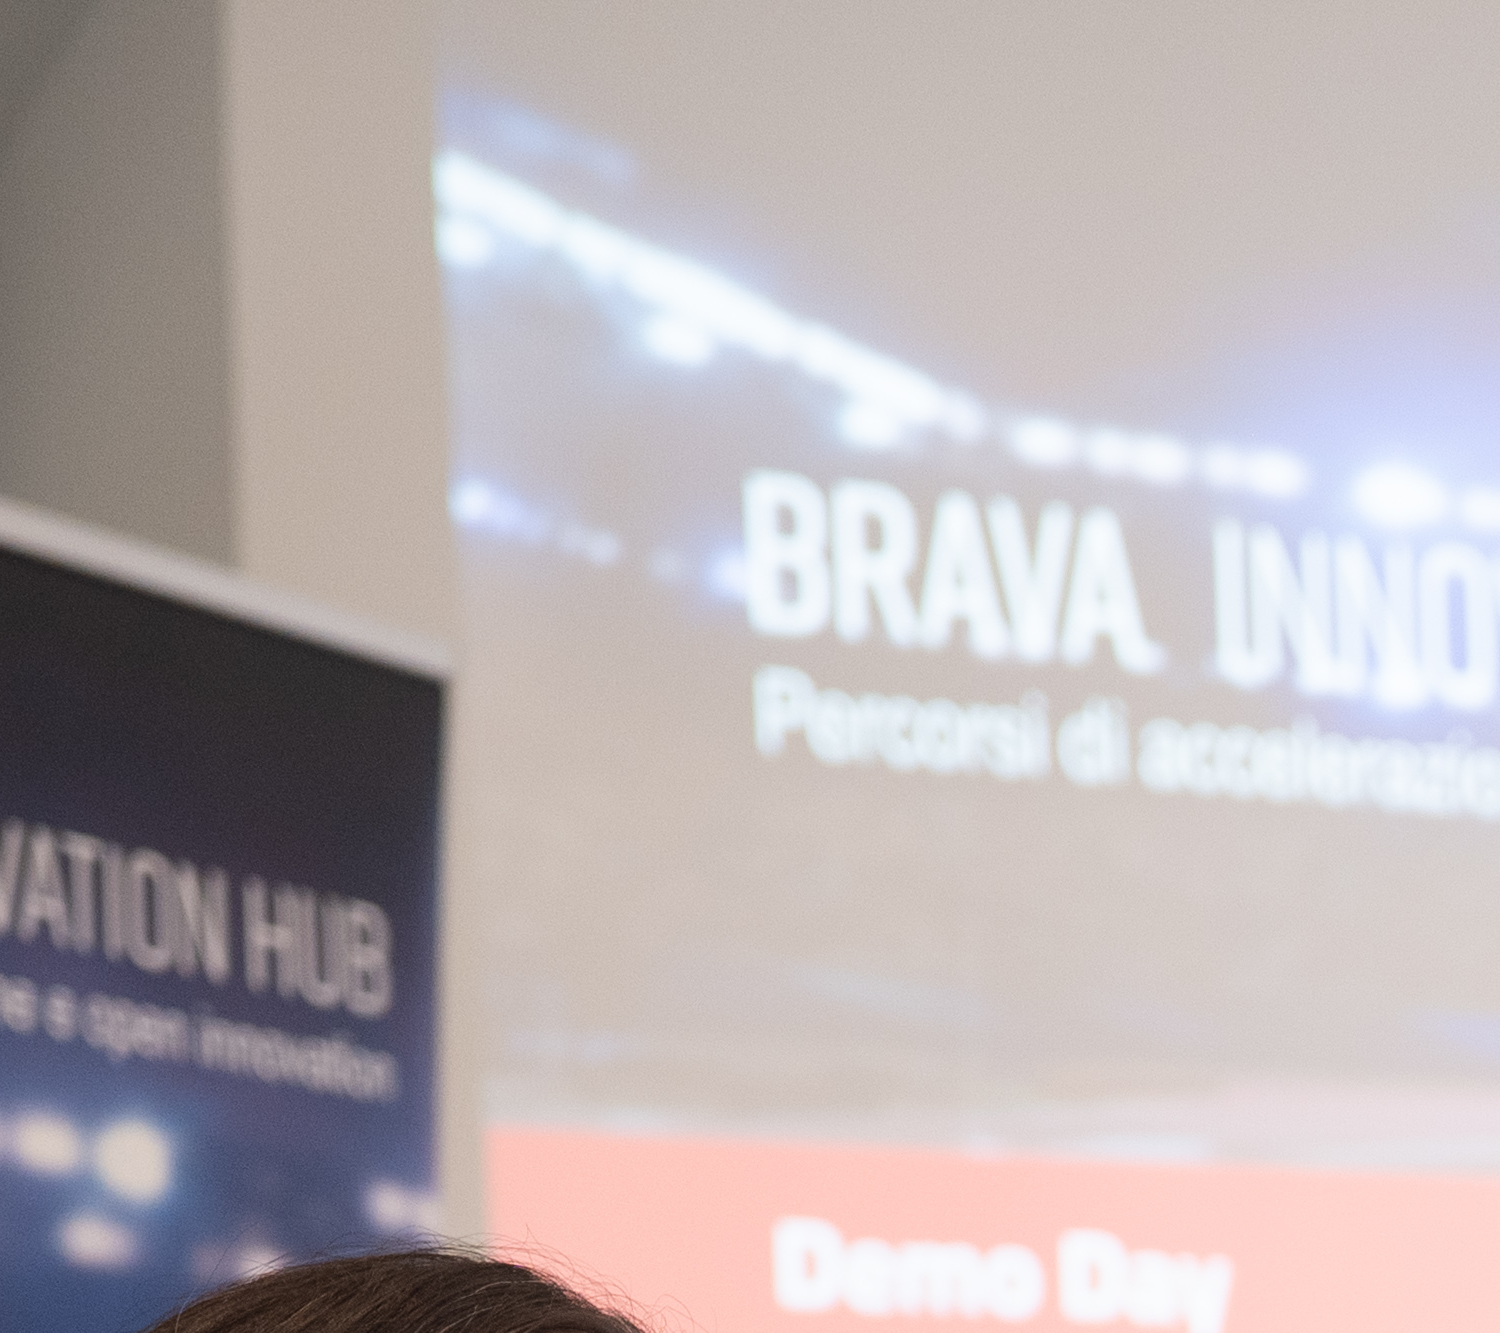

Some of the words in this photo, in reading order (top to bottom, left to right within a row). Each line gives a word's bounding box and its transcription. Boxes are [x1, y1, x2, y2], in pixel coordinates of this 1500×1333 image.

[743, 469, 1148, 670] BRAVA
[753, 664, 1051, 780] Percorsi
[1056, 692, 1134, 787] di
[242, 874, 396, 1020] HUB
[771, 1213, 1046, 1325] Demo
